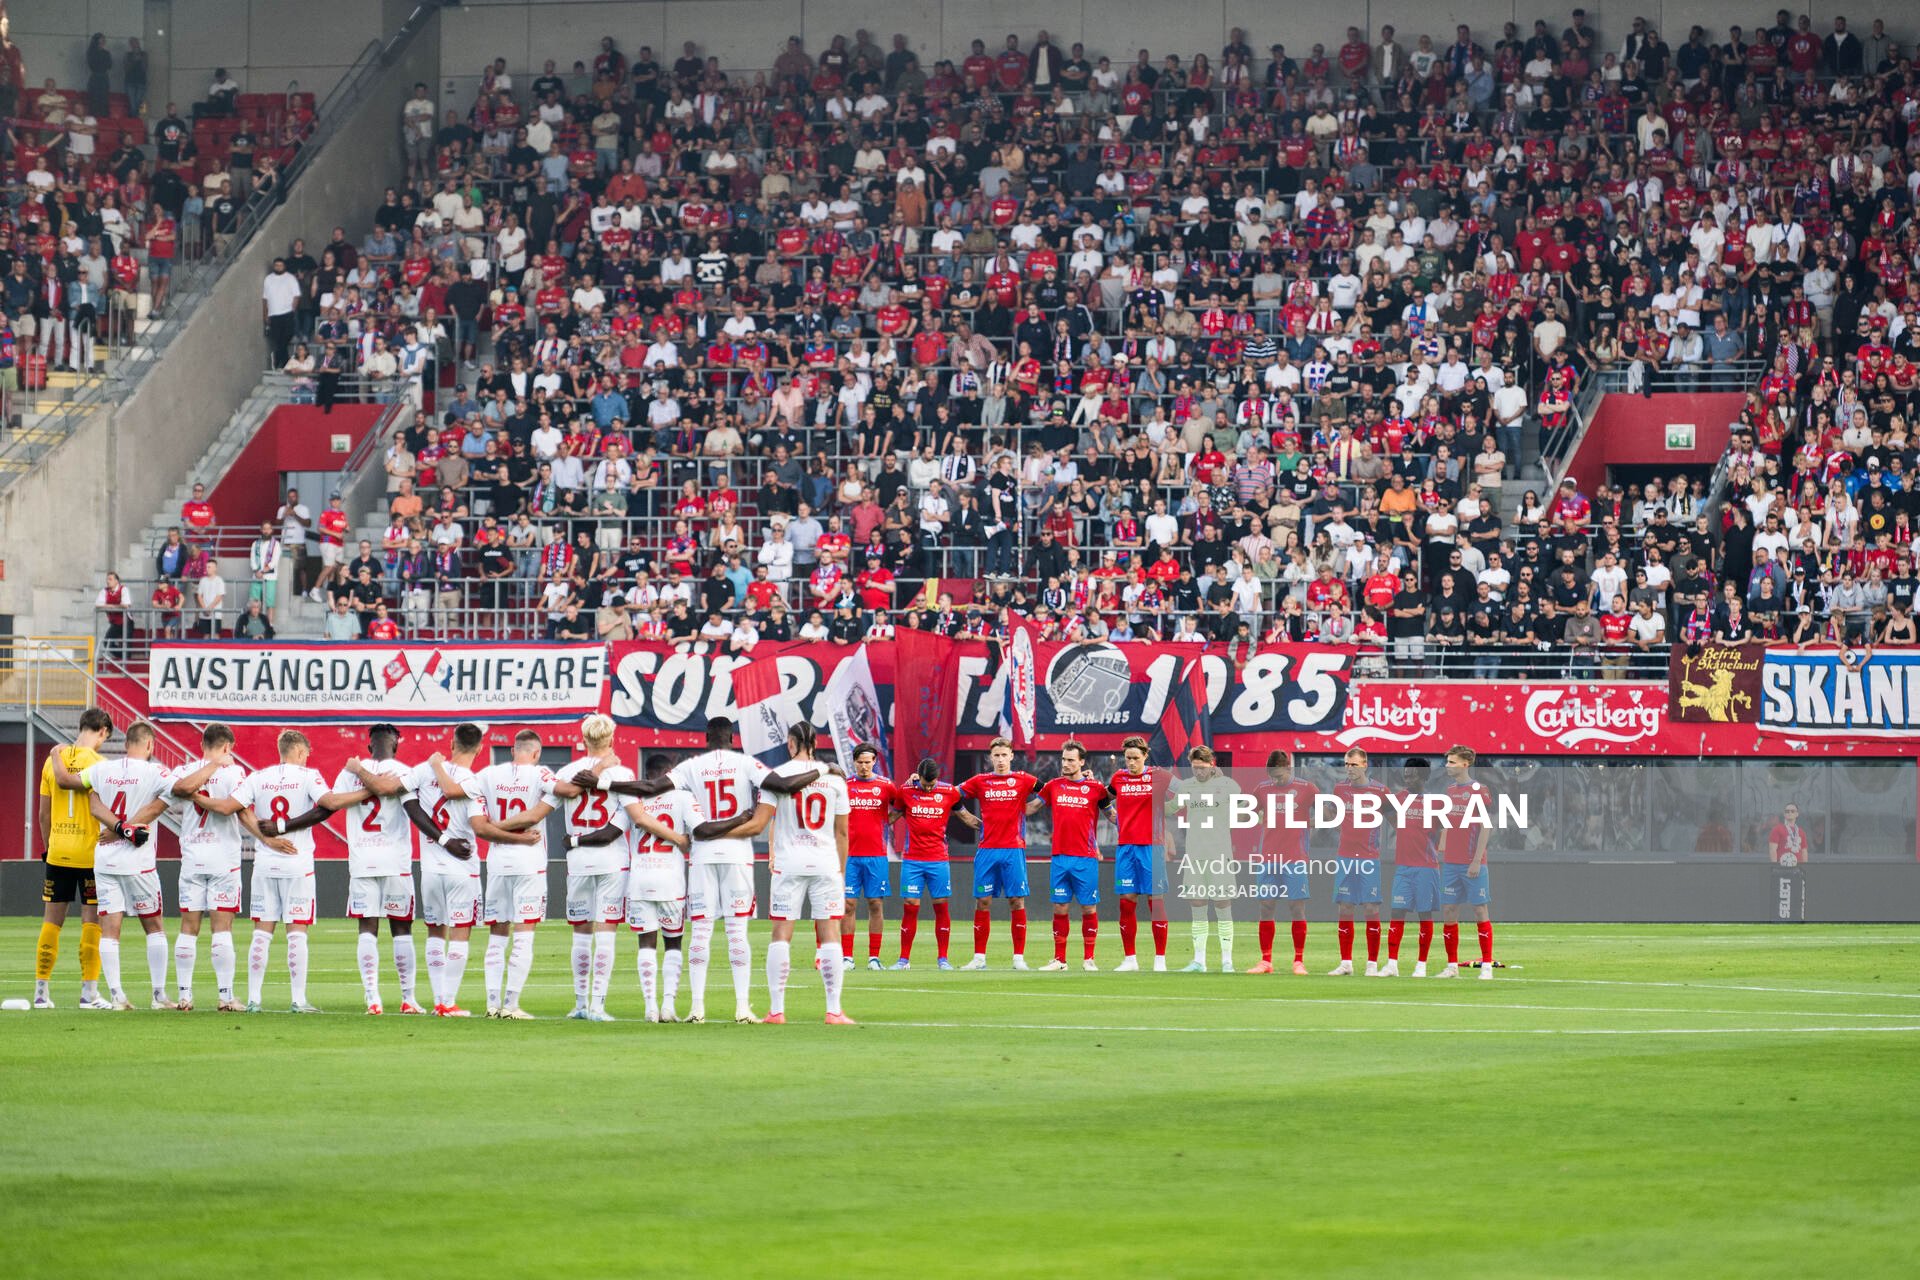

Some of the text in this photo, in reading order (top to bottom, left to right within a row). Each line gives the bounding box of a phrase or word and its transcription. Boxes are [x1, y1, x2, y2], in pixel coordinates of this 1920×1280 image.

[159, 652, 377, 691] AVSTÄNGDA
[1696, 658, 1759, 671] Skåneland
[1702, 647, 1742, 661] Befria
[457, 656, 600, 691] HIF:ARE
[1762, 650, 1920, 724] SKÅN
[181, 692, 195, 701] ER
[210, 692, 258, 702] FLAGGAR
[270, 693, 318, 703] SJUNGER
[321, 690, 363, 703] SÅNGER
[366, 692, 384, 703] OM
[456, 691, 483, 703] VÅRT
[485, 692, 505, 703] LAG
[509, 692, 520, 702] DI
[552, 690, 571, 701] BLÅ
[1525, 690, 1660, 737] Carlsberg
[1343, 697, 1439, 737] rlsberg
[110, 791, 127, 821] 4
[270, 795, 290, 822] 8
[571, 789, 609, 829] 23
[643, 803, 673, 813] ogsmat
[704, 778, 738, 820] 15
[790, 791, 827, 831] 10
[849, 797, 872, 806] akea
[911, 806, 934, 814] akea
[984, 789, 1007, 798] akea
[1056, 794, 1079, 804] akea
[361, 795, 381, 832] 2
[432, 795, 450, 831] 6
[637, 813, 675, 855] 22
[1779, 877, 1791, 919] SELECT
